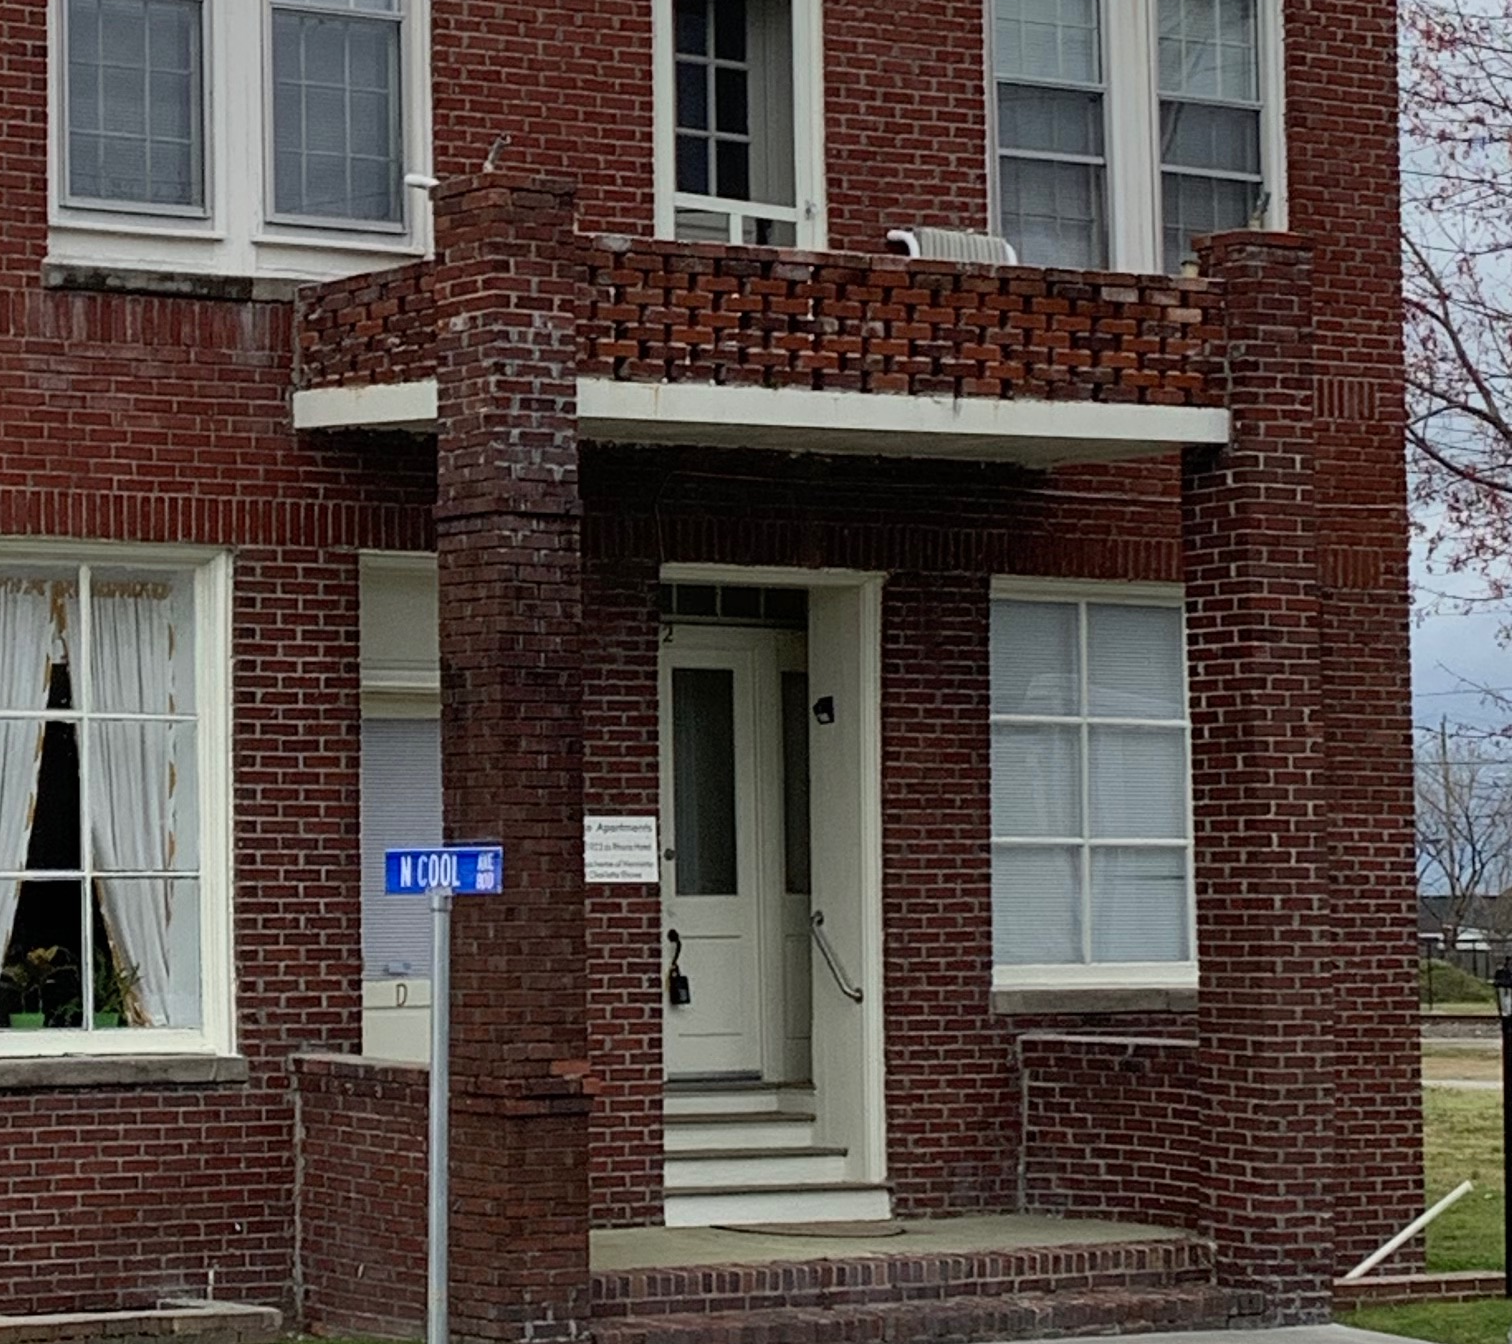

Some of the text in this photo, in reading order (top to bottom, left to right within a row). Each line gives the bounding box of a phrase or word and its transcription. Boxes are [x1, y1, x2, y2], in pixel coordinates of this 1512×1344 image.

[400, 853, 462, 888] N COOL
[396, 982, 408, 1008] D
